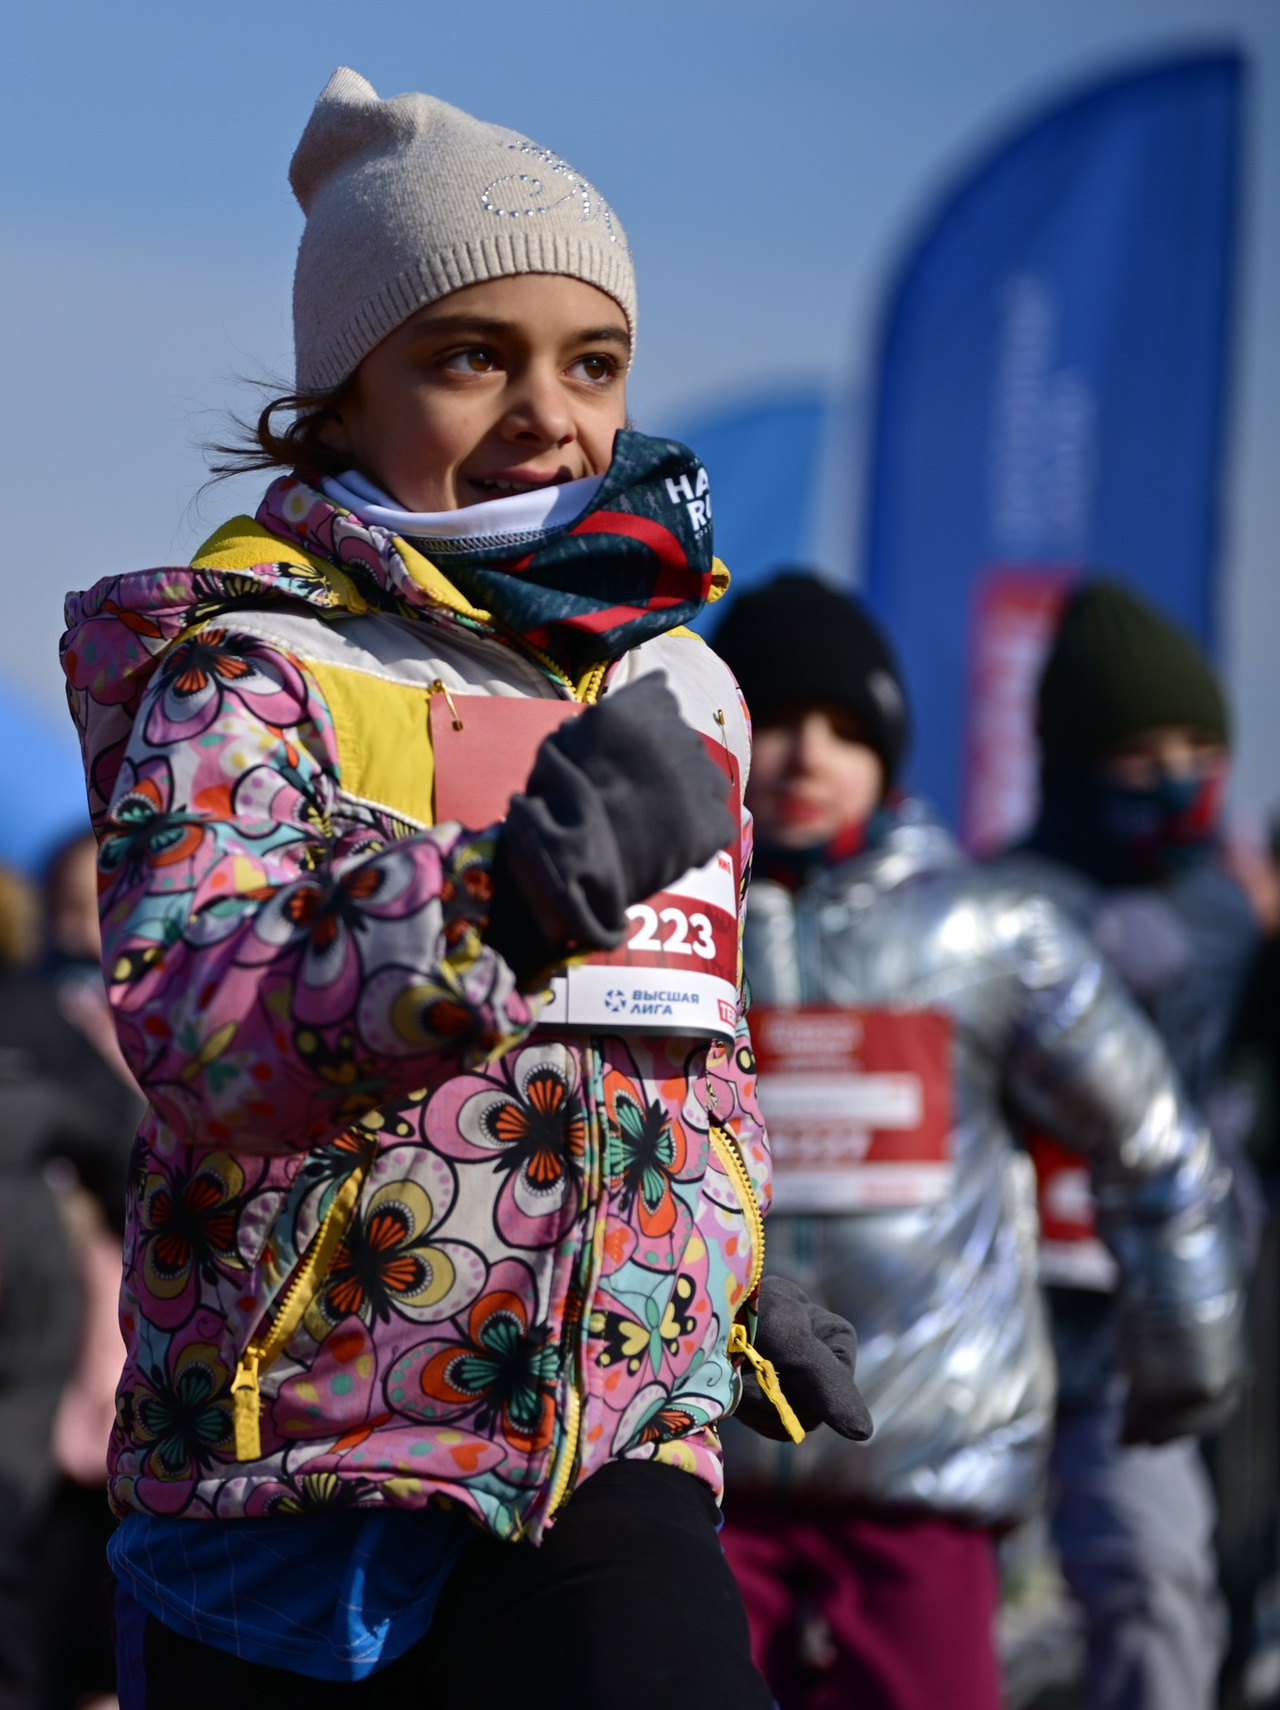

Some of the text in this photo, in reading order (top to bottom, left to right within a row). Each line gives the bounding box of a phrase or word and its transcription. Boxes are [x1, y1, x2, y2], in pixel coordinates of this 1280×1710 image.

[624, 904, 716, 960] 223
[632, 990, 699, 1004] ВЫСШАЯ
[630, 1004, 673, 1015] ЛИГА
